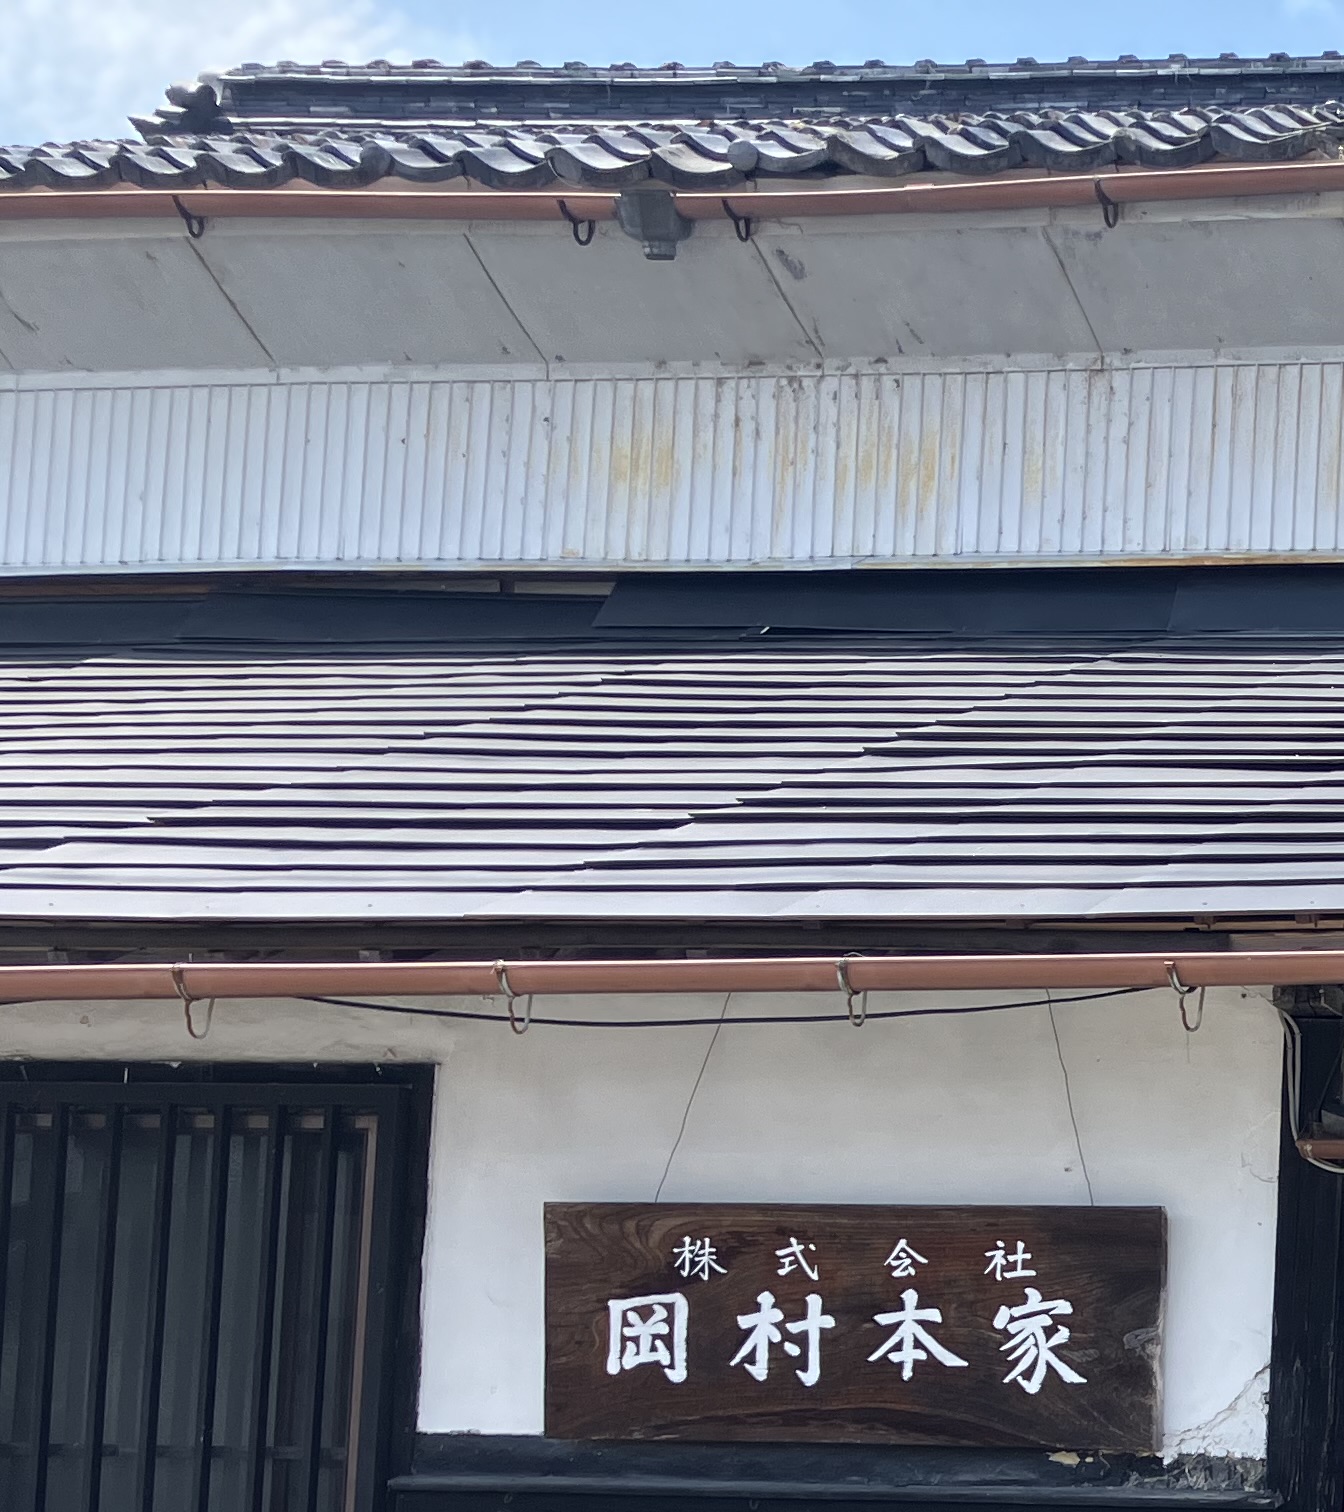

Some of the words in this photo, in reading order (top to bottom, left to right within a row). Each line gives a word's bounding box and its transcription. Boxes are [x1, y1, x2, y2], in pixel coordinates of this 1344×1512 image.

[673, 1236, 1038, 1281] 株式会社
[605, 1289, 1088, 1394] 岡村本家
